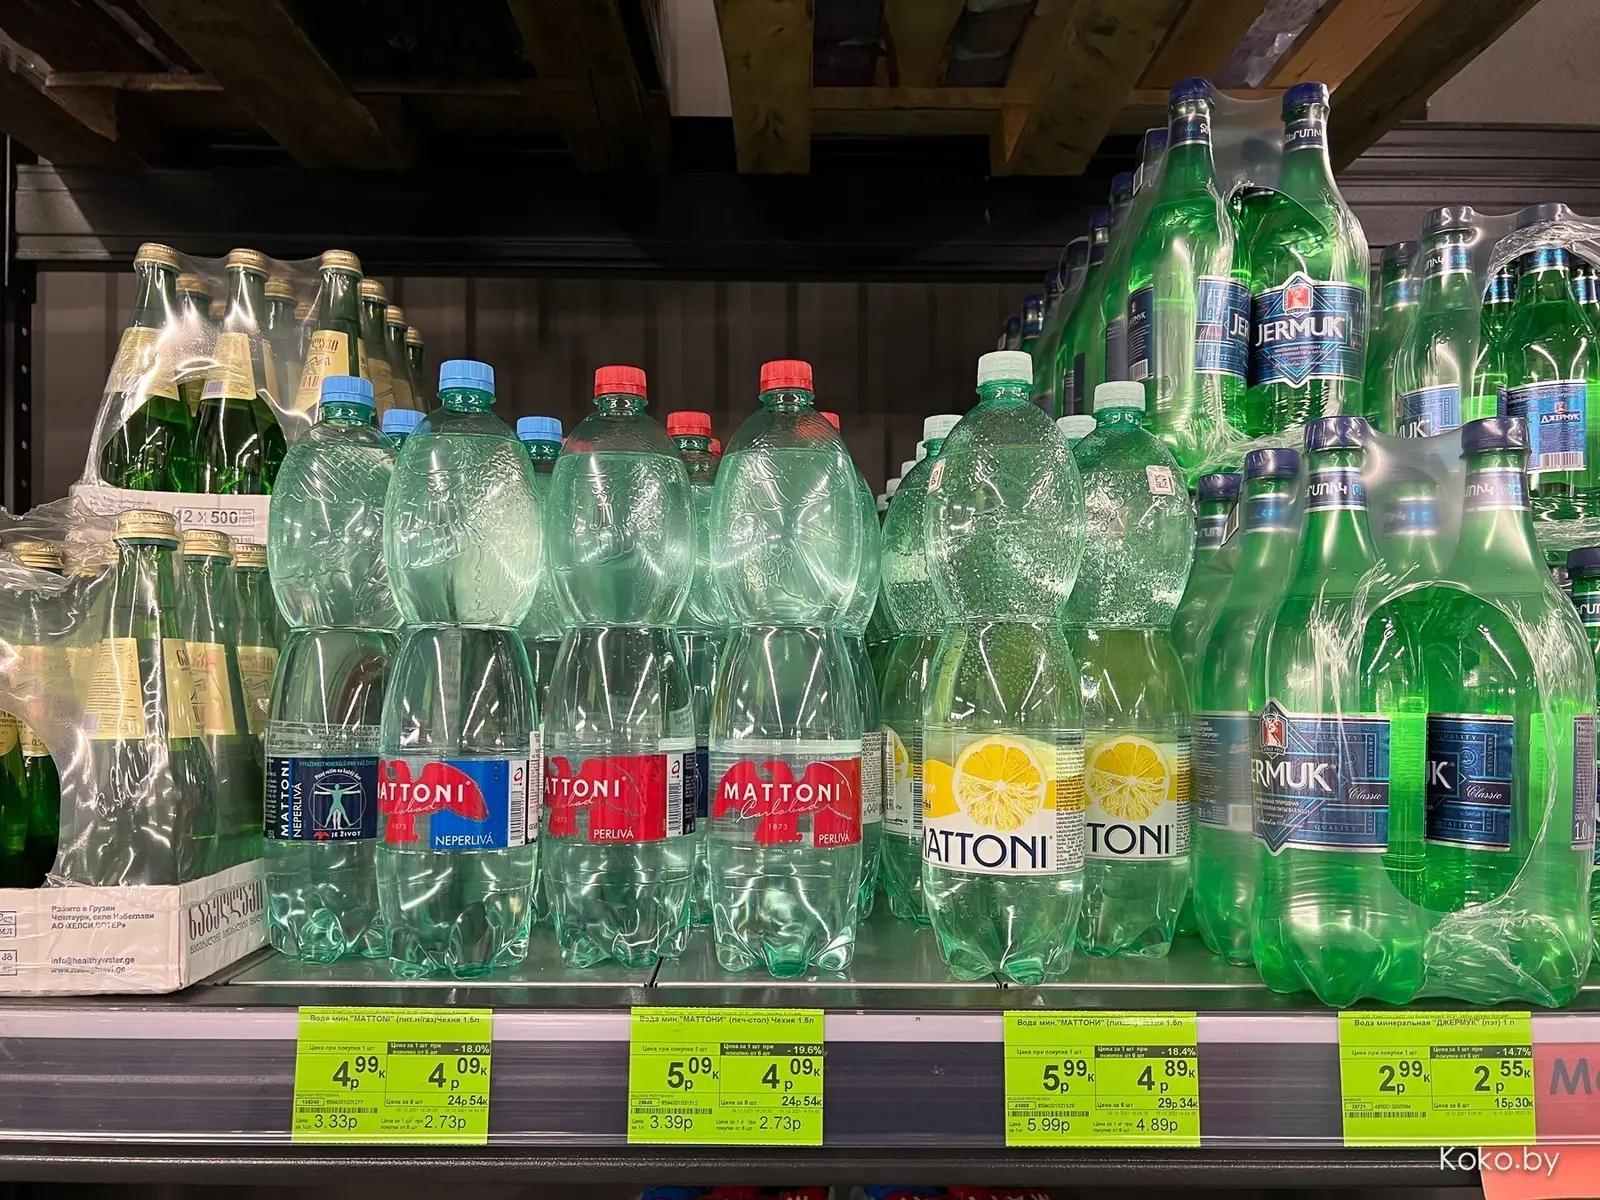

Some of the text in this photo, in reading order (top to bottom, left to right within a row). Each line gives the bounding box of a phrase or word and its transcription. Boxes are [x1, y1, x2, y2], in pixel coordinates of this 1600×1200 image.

[1255, 316, 1344, 347] JERMUK
[176, 510, 193, 523] 12
[211, 511, 238, 524] 500
[281, 761, 289, 837] MATTONI
[724, 782, 840, 802] MATTONI
[1349, 787, 1381, 800] Classic
[1467, 786, 1503, 800] Classic
[291, 783, 302, 837] NEPERLIVÁ
[736, 796, 820, 823] Carlsbad
[1436, 820, 1475, 829] QUALITY
[435, 832, 494, 846] NEPERLIVÁ
[593, 826, 634, 839] PERLIVÁ
[819, 830, 850, 844] PERLIVÁ
[461, 1045, 490, 1053] 18.0%
[794, 1046, 821, 1054] 19.6%
[1168, 1048, 1196, 1056] 18.4%
[1503, 1048, 1531, 1056] 14.7%
[448, 1095, 467, 1107] 24р
[782, 1096, 801, 1108] 24р
[1158, 1098, 1177, 1109] 29р
[1495, 1098, 1513, 1109] 15р
[315, 1114, 357, 1131] 3.33р
[425, 1115, 466, 1130] 2.73р
[650, 1115, 692, 1131] 3.39р
[760, 1116, 801, 1131] 2.73р
[1028, 1118, 1070, 1134] 5.99р
[1136, 1118, 1178, 1133] 4.89р
